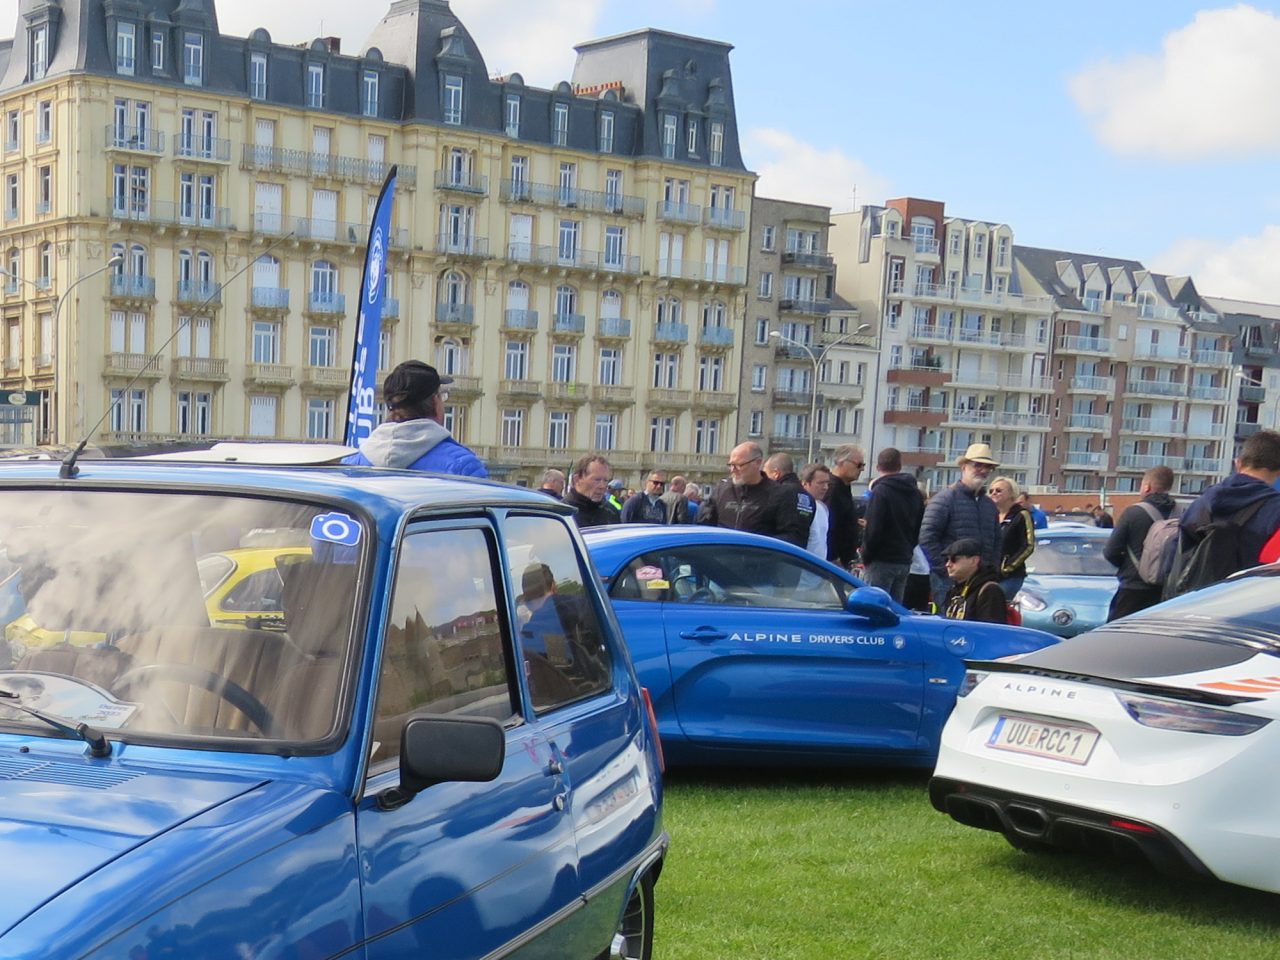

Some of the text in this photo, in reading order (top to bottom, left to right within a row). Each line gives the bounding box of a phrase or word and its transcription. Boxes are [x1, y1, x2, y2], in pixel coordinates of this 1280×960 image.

[729, 633, 885, 646] ALPINE DRIVERS CLUB
[1004, 682, 1077, 699] ALPINE
[1006, 722, 1083, 756] UU RCC 1
